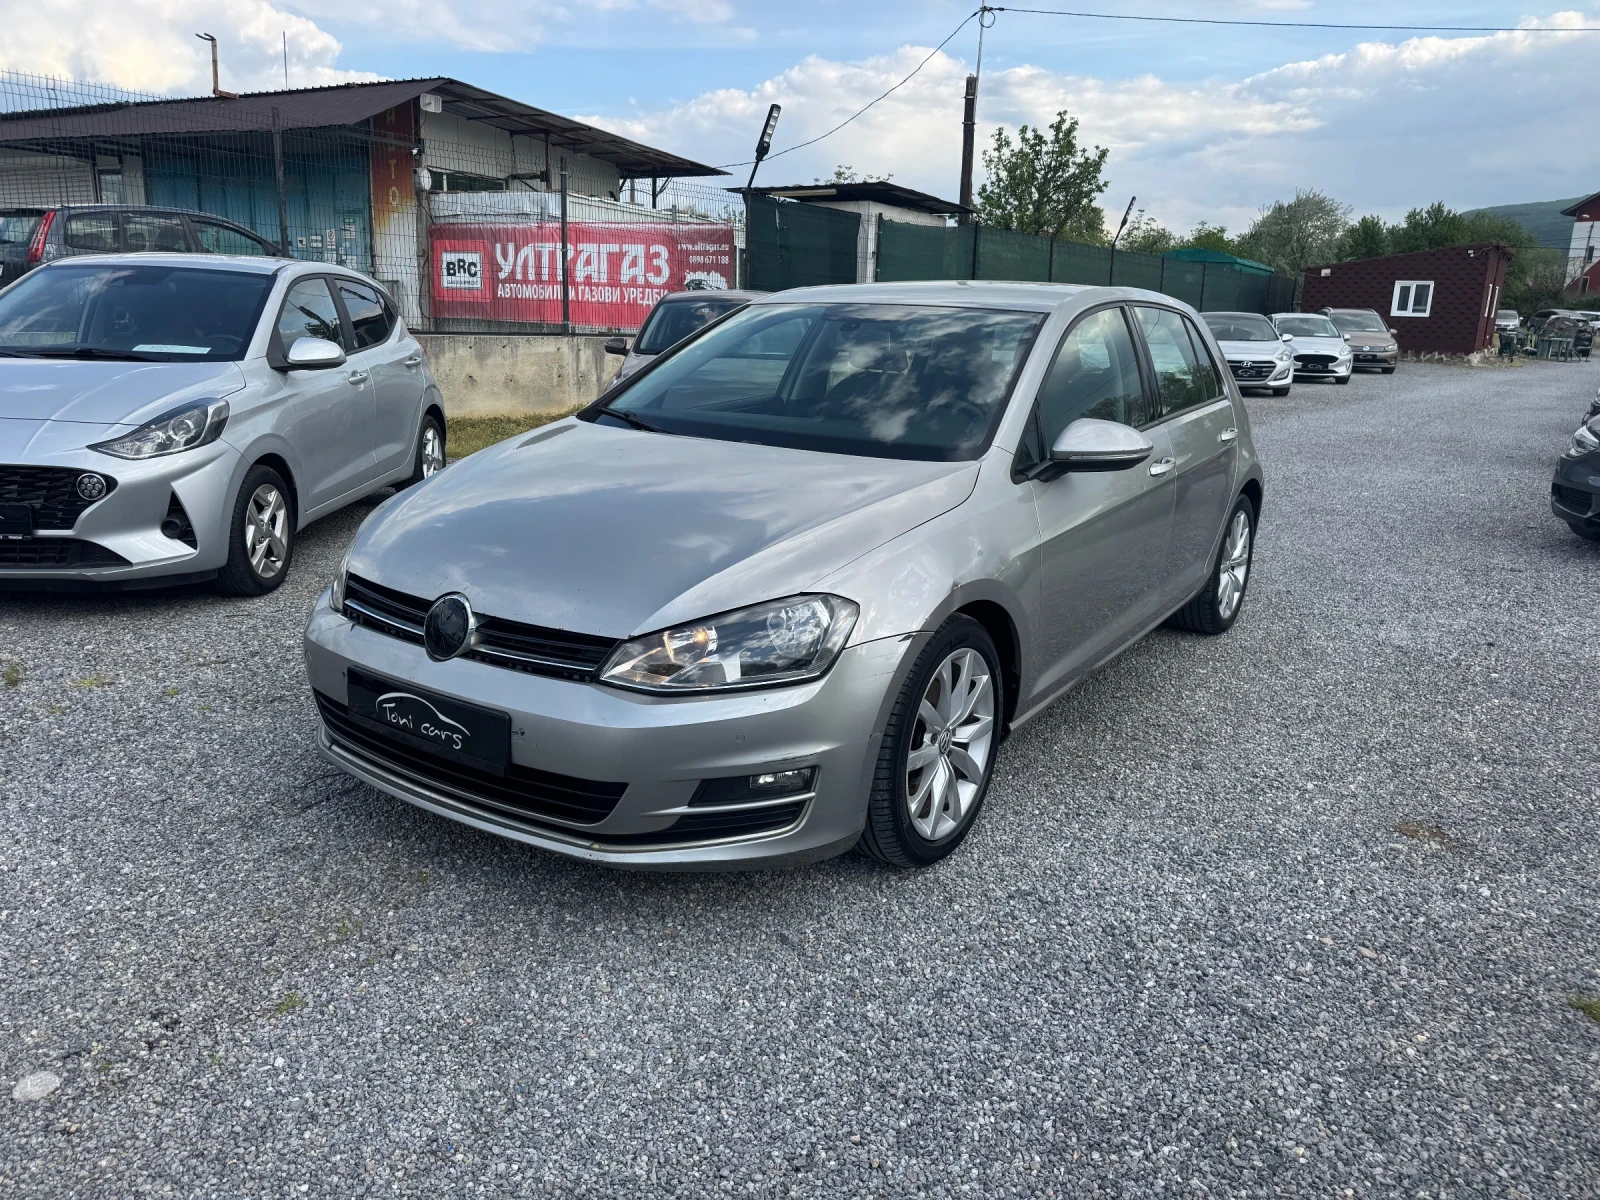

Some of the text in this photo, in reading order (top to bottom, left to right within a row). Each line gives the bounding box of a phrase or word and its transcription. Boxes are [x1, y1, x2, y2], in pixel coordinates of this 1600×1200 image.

[446, 258, 478, 278] BRC
[497, 243, 670, 285] УЛТРАГАЗ
[688, 255, 730, 265] 0898 671 188
[578, 285, 621, 303] ГАЗОВИ
[382, 702, 462, 750] Toni cars
